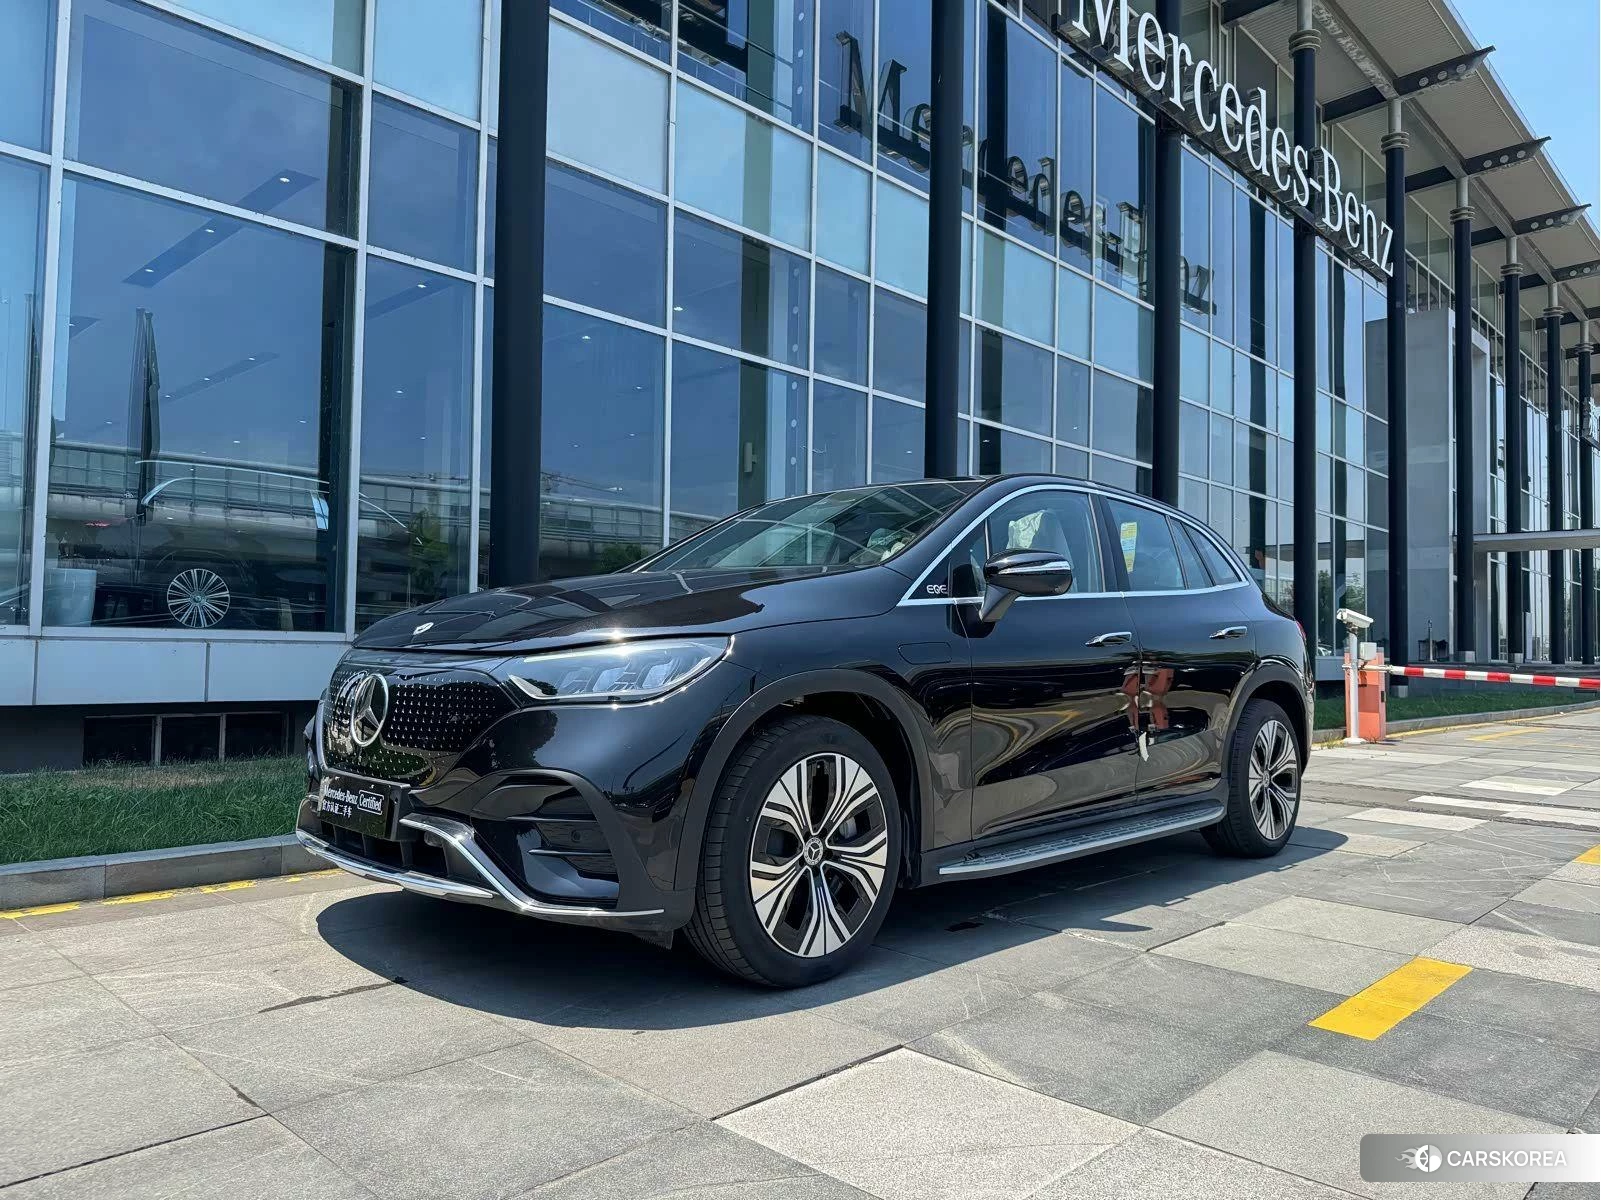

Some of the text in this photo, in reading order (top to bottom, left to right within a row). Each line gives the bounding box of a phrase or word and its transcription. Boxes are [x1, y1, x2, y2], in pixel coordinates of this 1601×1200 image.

[1072, 0, 1393, 277] Mercedes-Benz
[926, 584, 948, 594] EQE
[323, 785, 382, 811] Mercedes-Benz Certified
